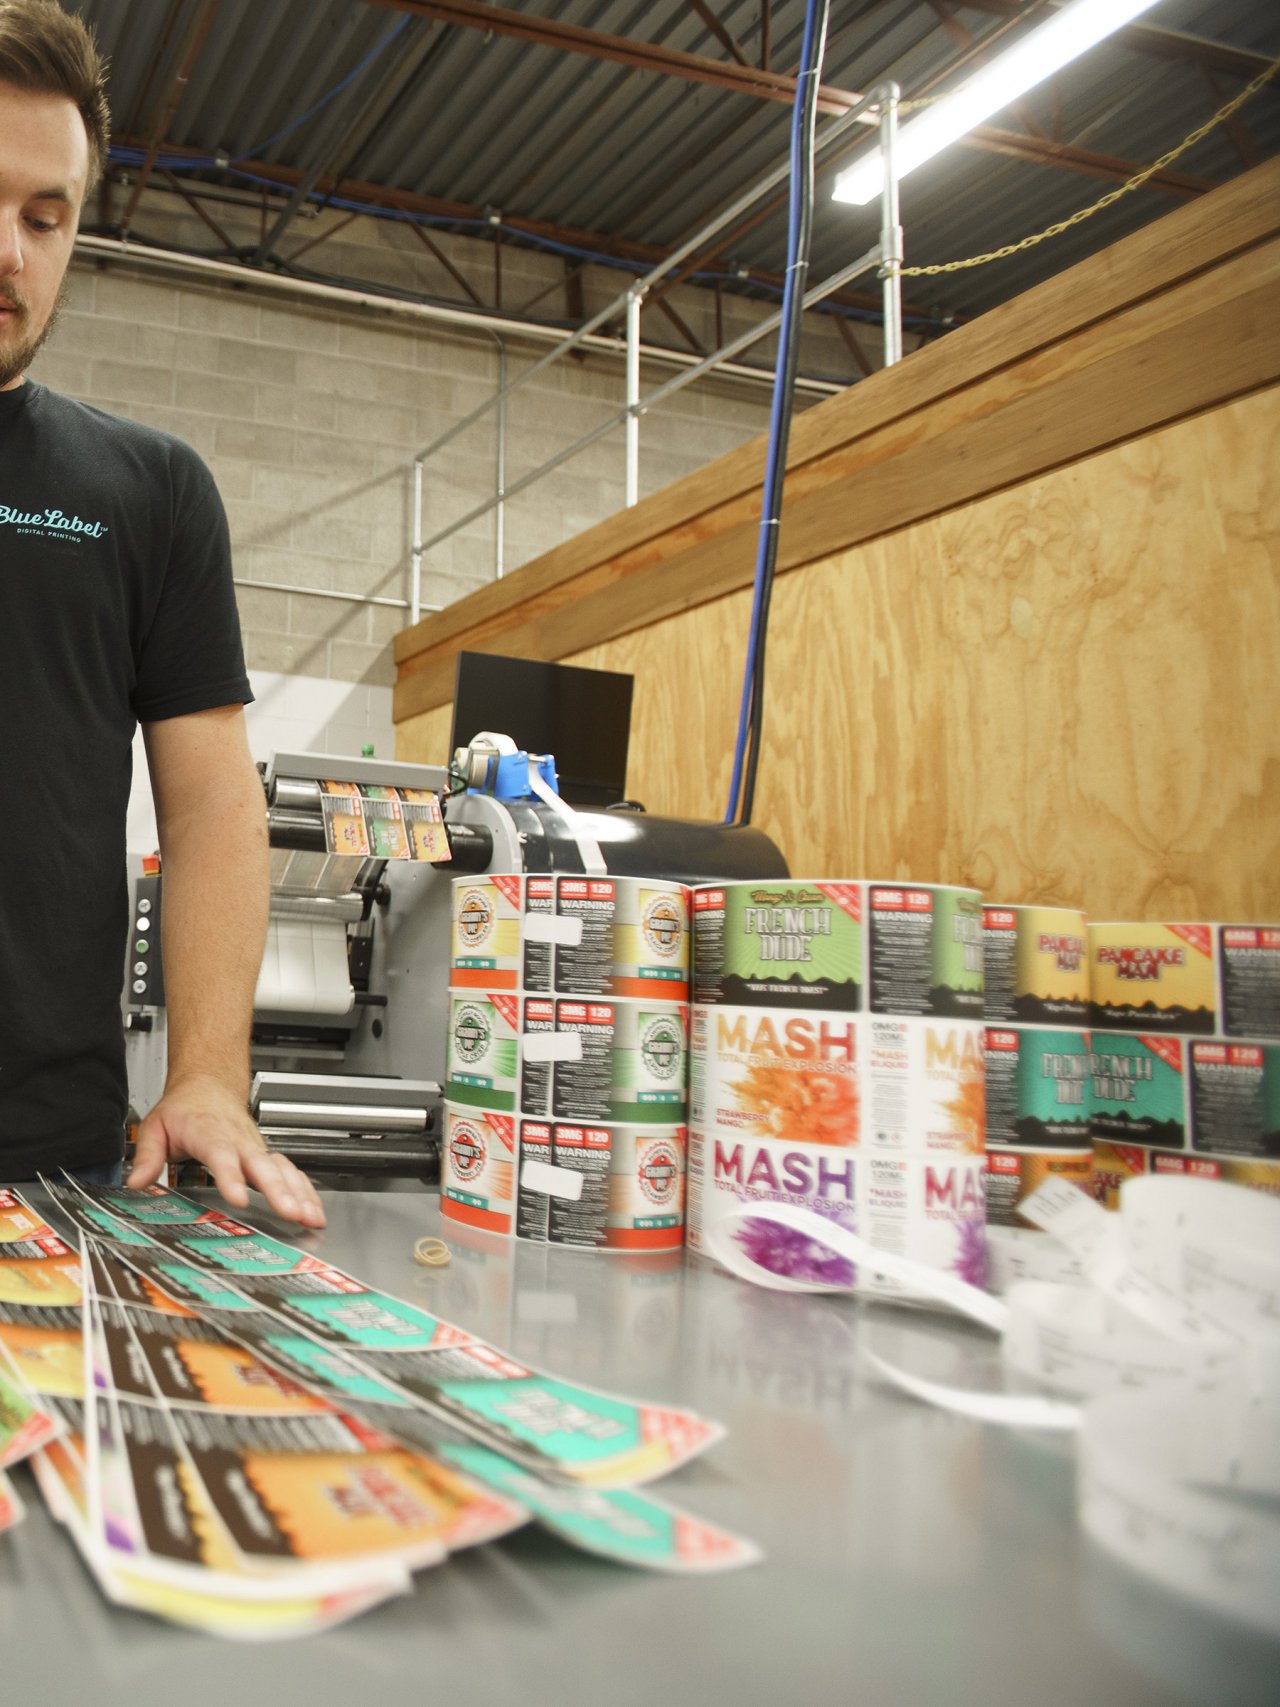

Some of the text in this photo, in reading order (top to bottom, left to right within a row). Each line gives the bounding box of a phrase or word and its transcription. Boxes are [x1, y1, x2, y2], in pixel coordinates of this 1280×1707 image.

[16, 528, 81, 543] DIGITAL PRINTING
[560, 881, 613, 894] 3MG 120
[560, 900, 615, 911] WARNING
[874, 892, 929, 905] 3MG 120
[745, 907, 832, 935] FRENCH
[874, 911, 933, 923] WARNING
[991, 913, 1013, 923] 120
[760, 935, 812, 962] DUDE
[1097, 947, 1185, 966] PANCAKE
[1116, 962, 1162, 981] MAN
[559, 1003, 611, 1018] 3MG 120
[560, 1022, 614, 1035] WARNING
[716, 1013, 856, 1062] MASH
[992, 1034, 1015, 1045] 120
[1233, 1047, 1259, 1060] 120
[716, 1052, 856, 1074] TOTAL FRUIT EXPLOSION
[1090, 1054, 1152, 1080] RENCH
[1194, 1063, 1263, 1075] WARNING
[716, 1108, 770, 1123] STRAWBERRY
[716, 1118, 744, 1129] MANGO
[556, 1127, 609, 1142] 3MG 120
[556, 1147, 611, 1160] WARNING
[994, 1157, 1017, 1167] 120
[1190, 1163, 1215, 1174] 120
[714, 1140, 855, 1199] MASH
[714, 1179, 855, 1213] TOTAL FRUIT EXPLOSION
